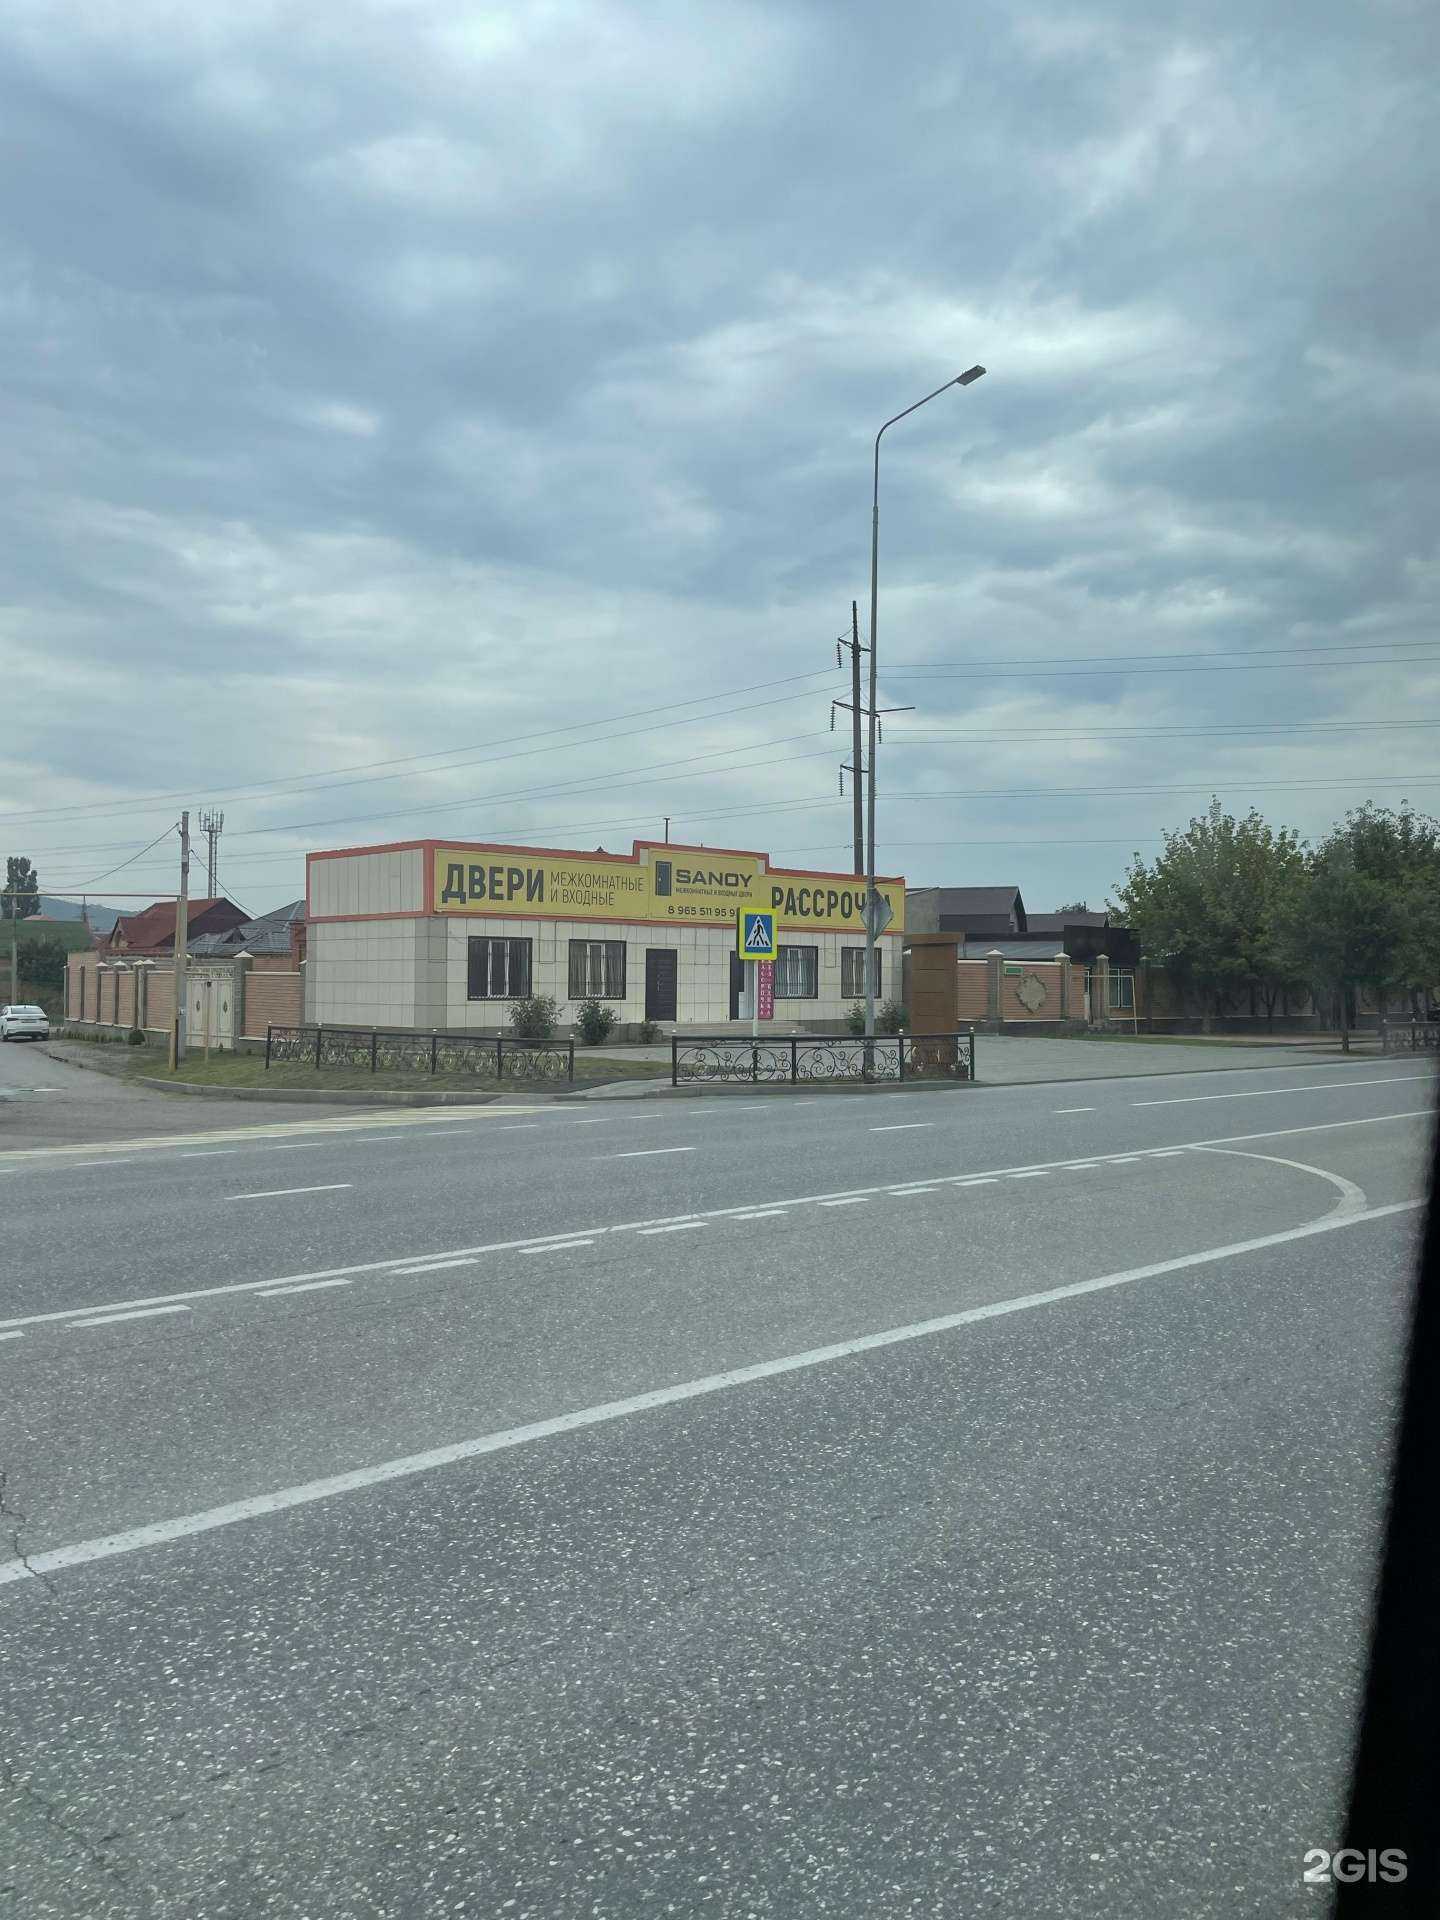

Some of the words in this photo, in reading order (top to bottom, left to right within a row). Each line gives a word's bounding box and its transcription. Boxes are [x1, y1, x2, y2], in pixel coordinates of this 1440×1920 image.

[441, 863, 545, 904] ДВЕРИ
[550, 871, 644, 892] МЕЖКОМНАТНЫЕ
[550, 888, 559, 903] И
[562, 890, 615, 907] ВХОДНЫЕ
[667, 905, 675, 914] 8
[677, 906, 697, 915] 965
[699, 907, 712, 916] 511
[714, 907, 727, 917] 95
